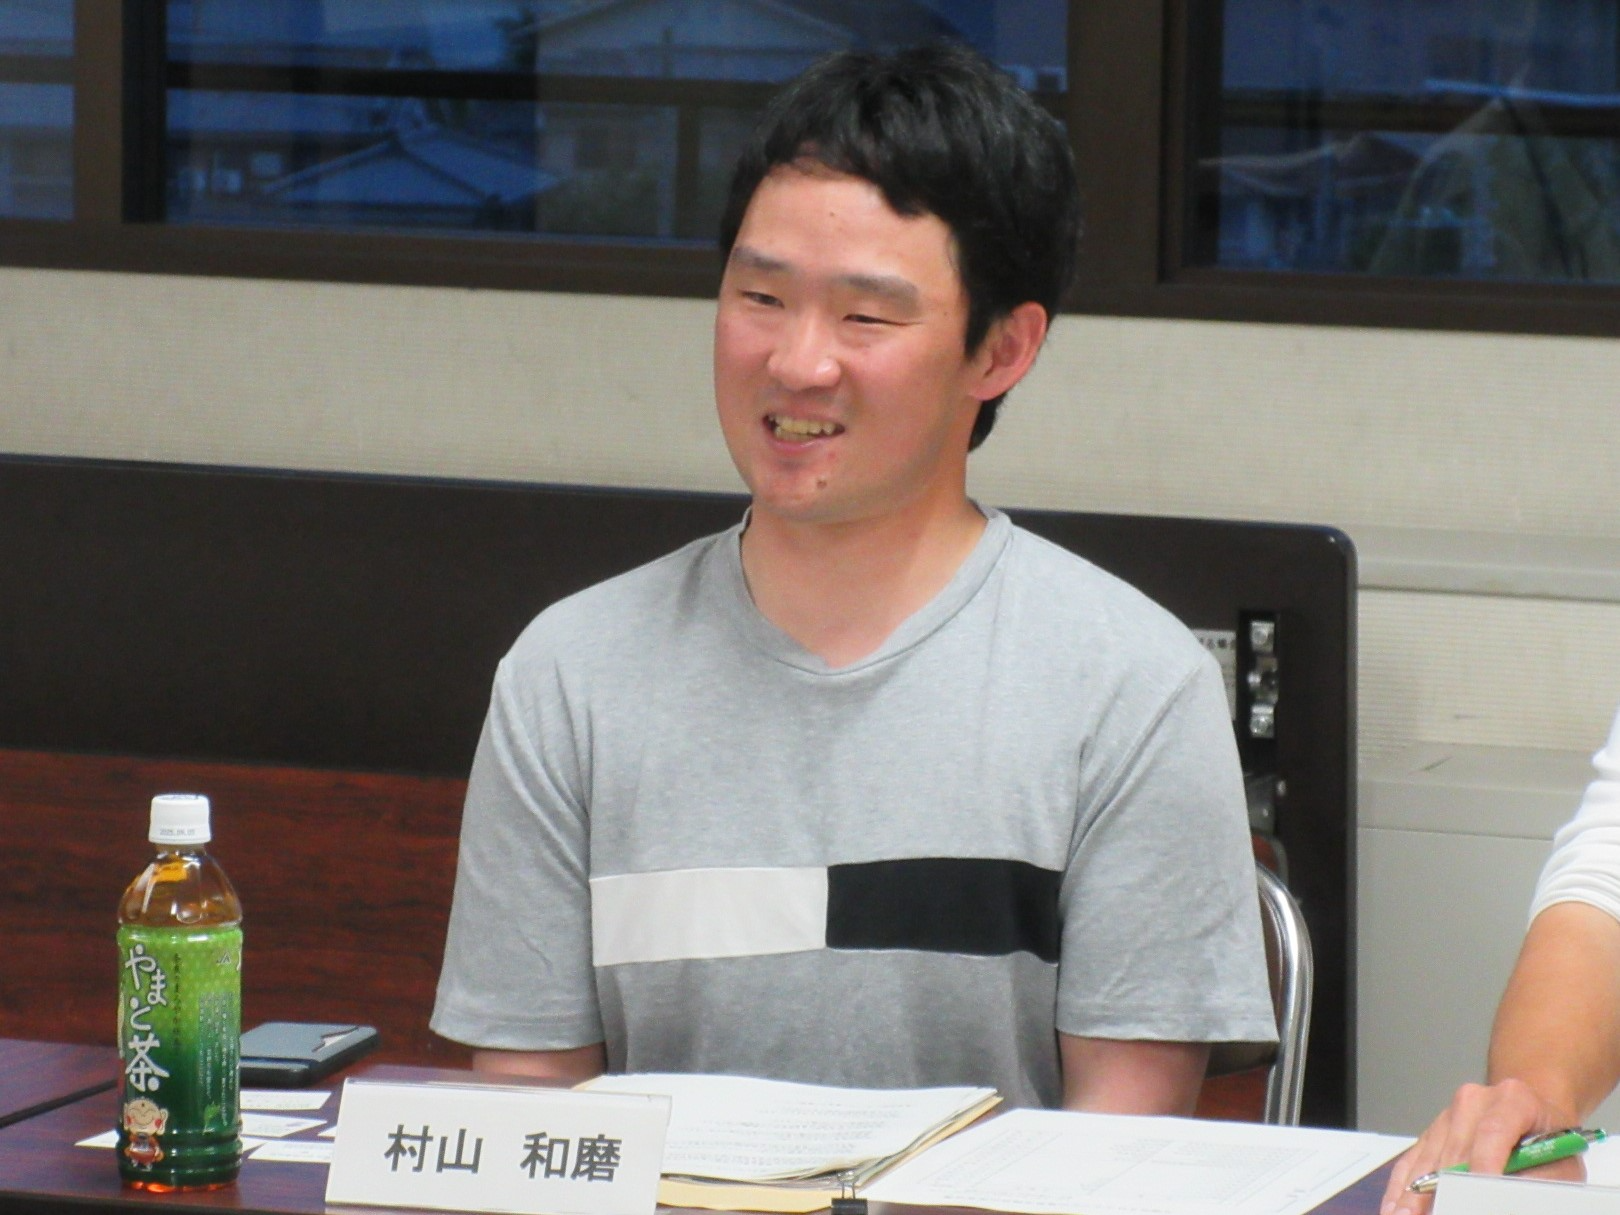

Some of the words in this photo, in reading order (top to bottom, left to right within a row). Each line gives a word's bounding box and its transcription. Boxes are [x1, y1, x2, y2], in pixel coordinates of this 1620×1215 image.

[124, 943, 170, 1092] やまと茶
[383, 1123, 484, 1174] 村山
[519, 1130, 623, 1183] 和磨
